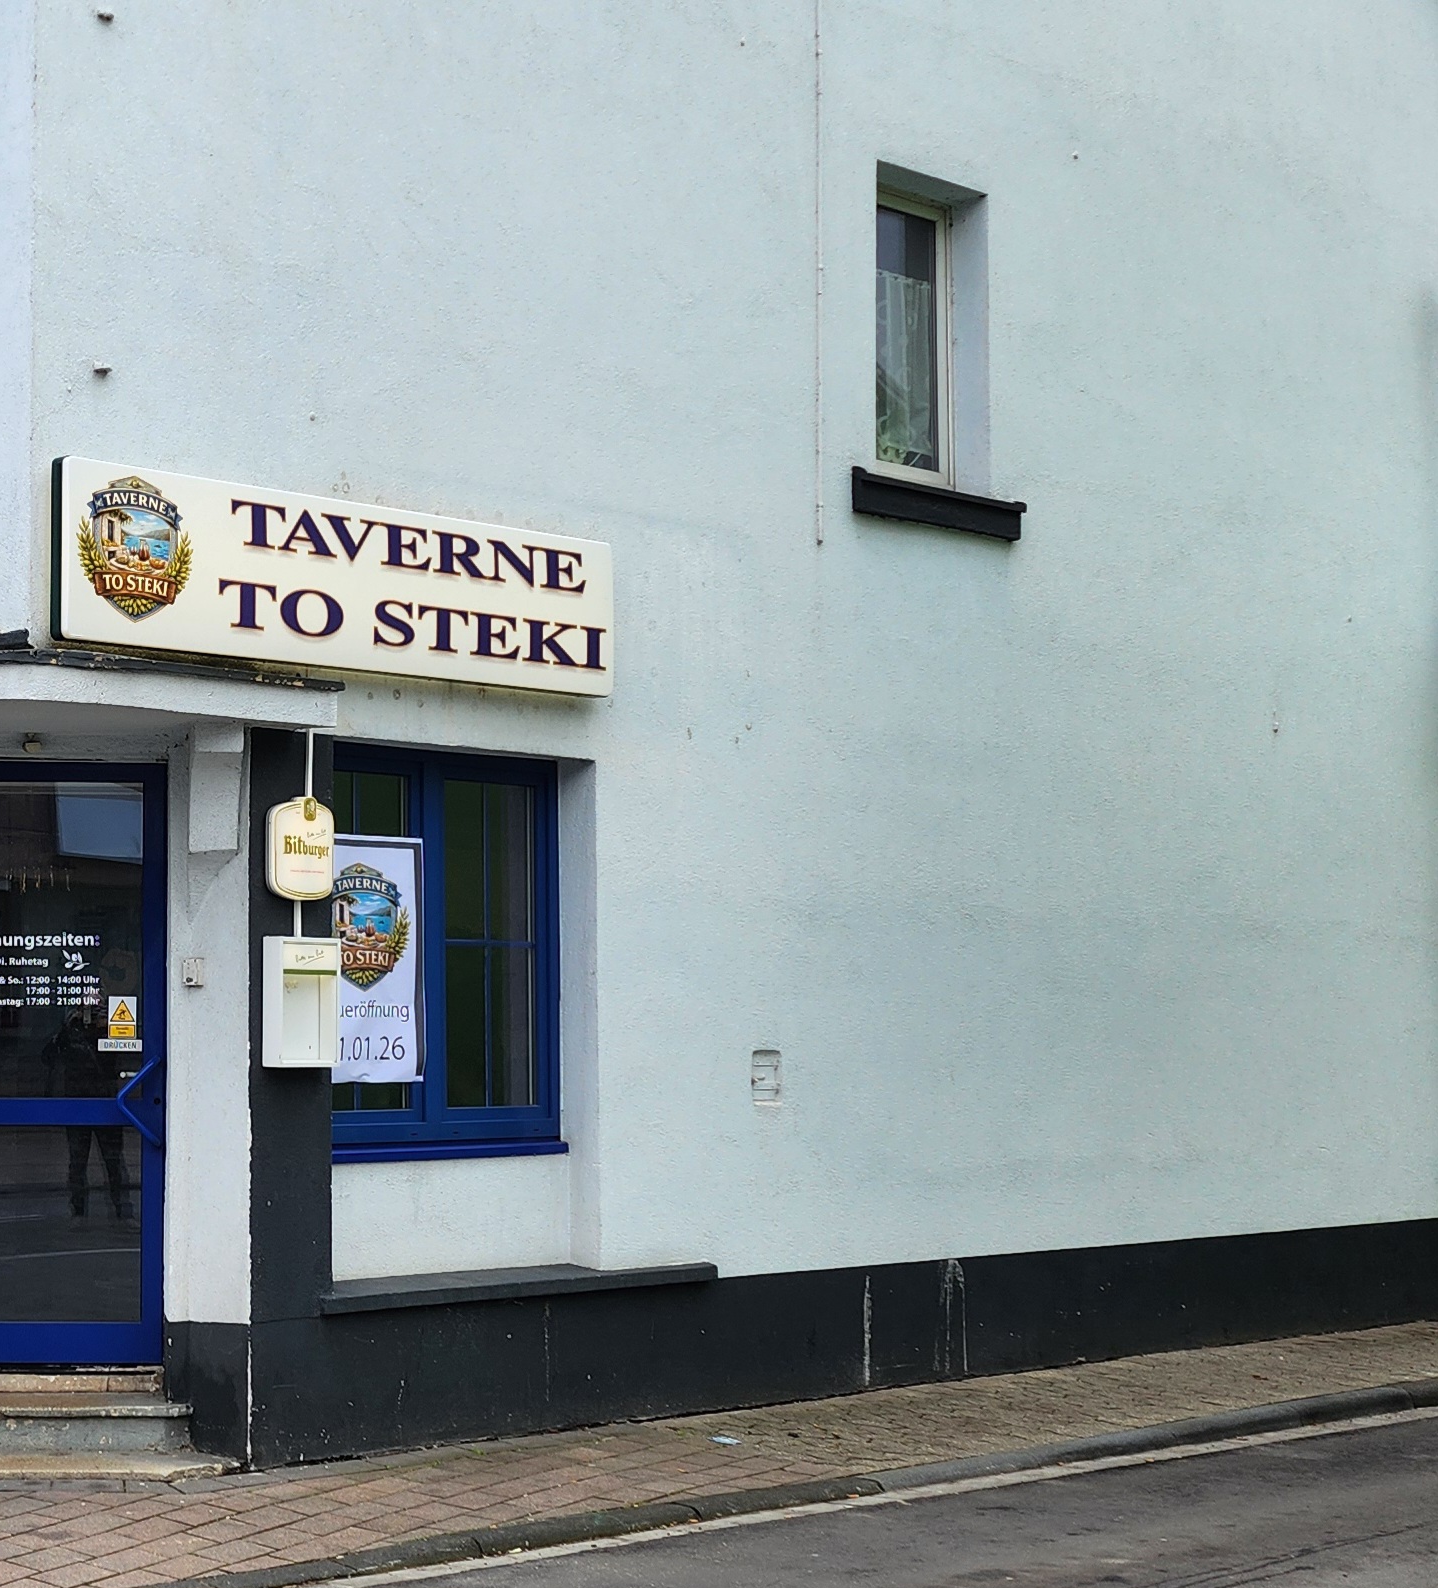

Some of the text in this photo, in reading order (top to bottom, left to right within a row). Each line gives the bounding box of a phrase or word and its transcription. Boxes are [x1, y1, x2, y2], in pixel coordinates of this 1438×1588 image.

[103, 492, 168, 515] TAVERNE
[231, 498, 587, 594] TAVERNE
[102, 574, 168, 597] TO STEKI
[218, 578, 607, 671] TO STEKI
[283, 835, 329, 859] Bitburger
[336, 877, 389, 894] TAVERNE
[8, 957, 49, 968] Ruhetag
[356, 950, 389, 967] STEKI
[25, 975, 51, 985] 12:00
[57, 975, 82, 985] 14:00
[82, 975, 100, 985] Uhr
[25, 986, 51, 996] 17:00
[56, 986, 82, 996] 21:00
[82, 986, 100, 996] Uhr
[25, 997, 51, 1006] 17:00
[56, 997, 82, 1006] 21:00
[82, 997, 101, 1006] Uhr
[103, 1039, 137, 1050] DRÜCKEN
[340, 1036, 405, 1061] 1.01.26
